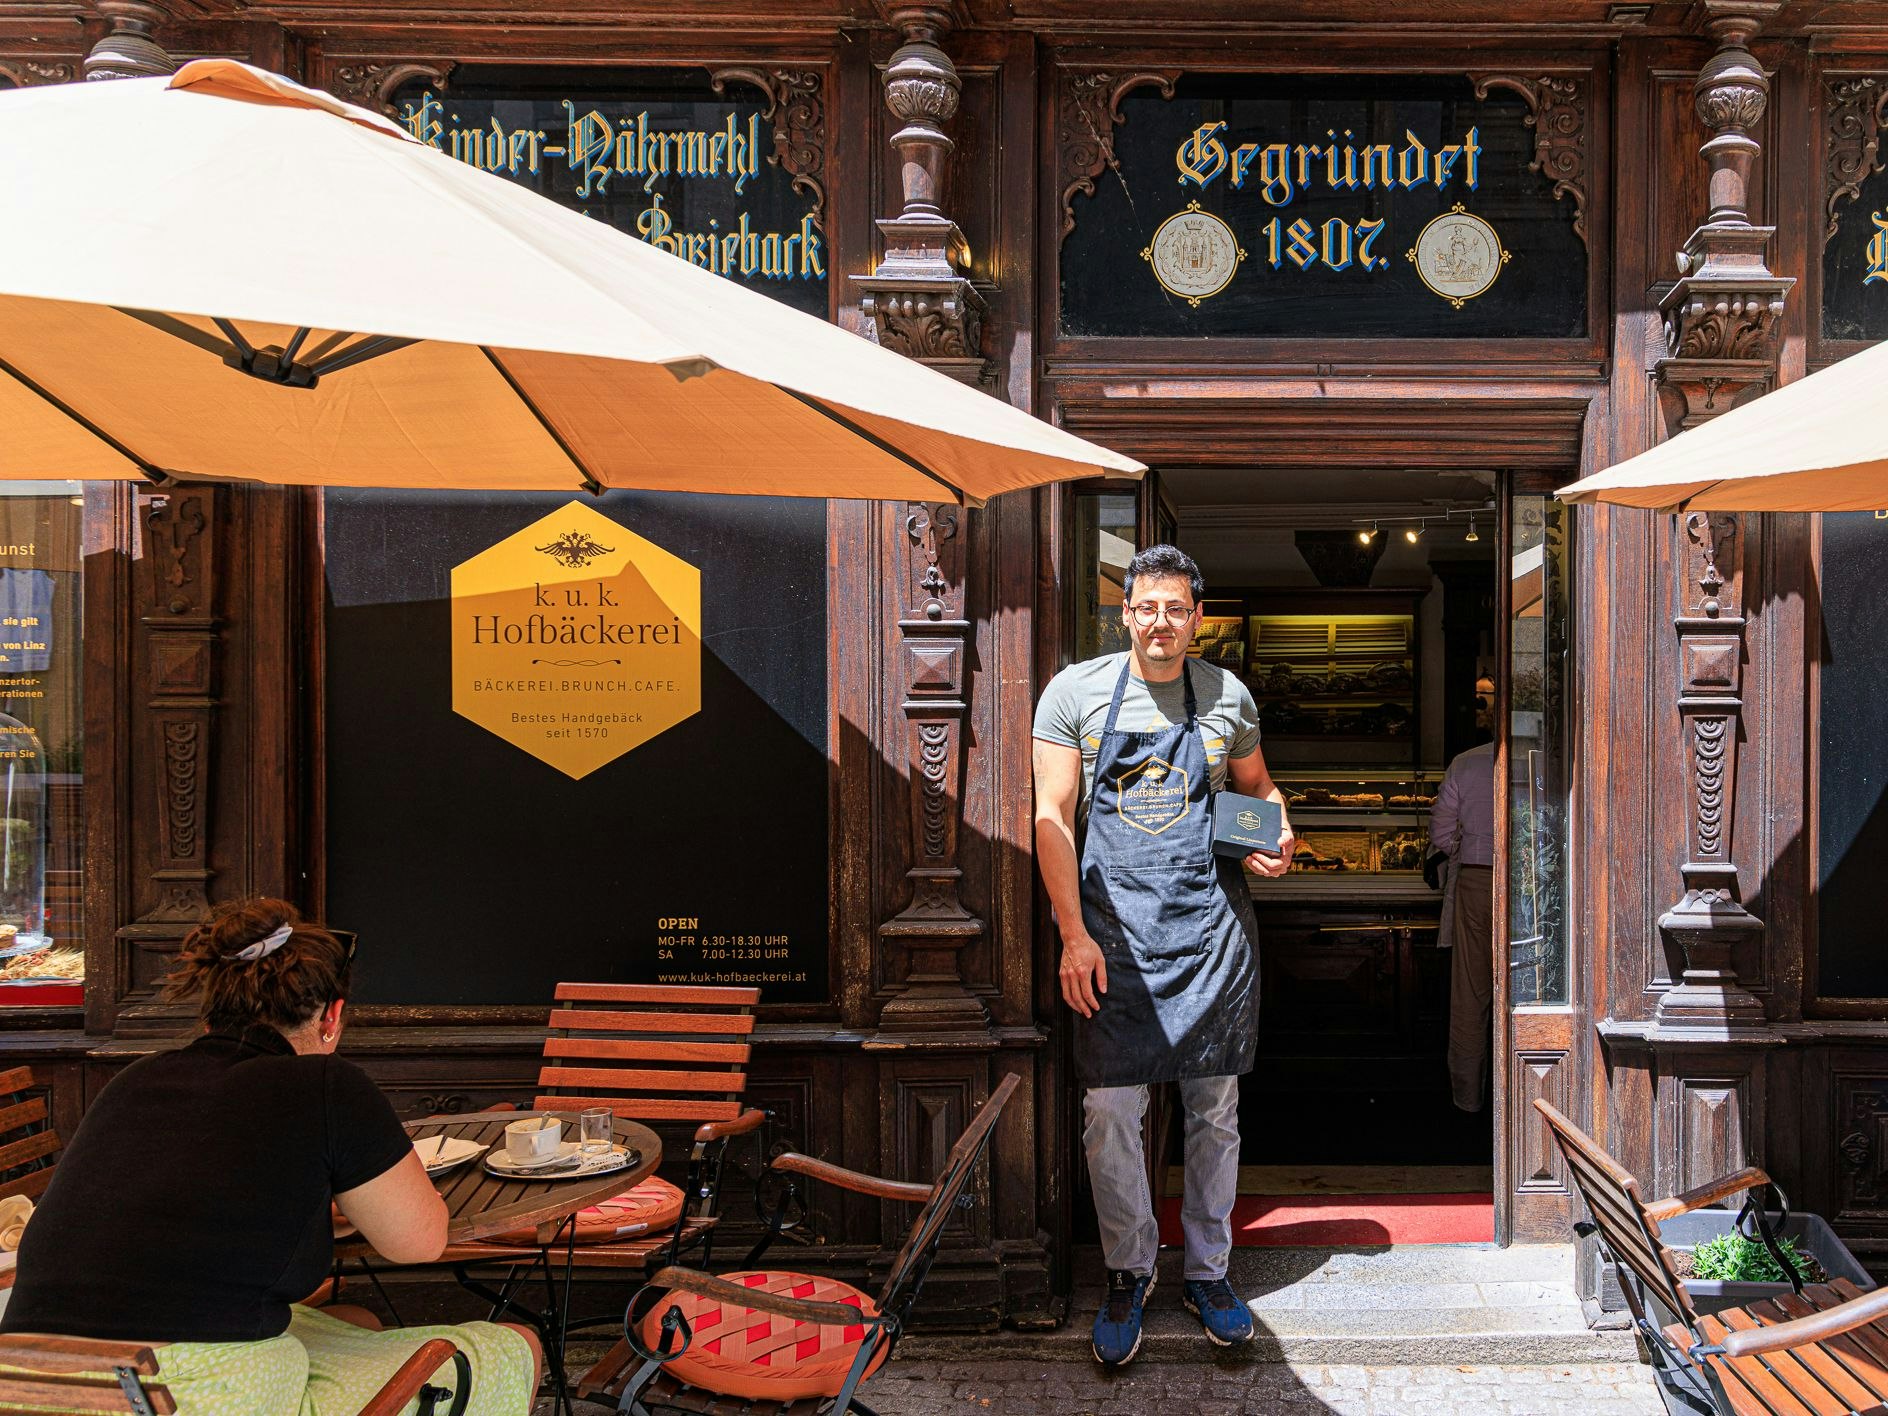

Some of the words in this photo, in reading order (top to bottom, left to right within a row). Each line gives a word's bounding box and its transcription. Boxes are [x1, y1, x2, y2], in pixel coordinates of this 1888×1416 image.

[1176, 120, 1482, 207] Gegründet
[1262, 216, 1390, 272] 1807.
[534, 583, 556, 607] k.
[565, 590, 588, 607] u.
[598, 583, 619, 607] k.
[20, 616, 39, 628] gilt
[472, 614, 682, 645] Hofbäckerei
[3, 642, 22, 650] von
[23, 640, 46, 650] Linz
[474, 678, 681, 692] BÄCKEREI.BRUNCH.CAFE.
[0, 689, 44, 698] rationen
[511, 712, 556, 723] Bestes
[562, 711, 643, 725] Handgebäck
[546, 727, 570, 738] seit
[577, 727, 609, 738] 1570
[19, 749, 36, 758] Sie
[1125, 785, 1184, 799] Hofbäckerei
[658, 917, 699, 930] OPEN
[658, 936, 695, 946] MO-FR
[702, 935, 761, 946] 6.30-18.30
[764, 935, 789, 945] UHR
[658, 949, 674, 959] SA
[702, 949, 761, 959] 7.00-12.30
[764, 948, 789, 959] UHR
[658, 971, 807, 983] www.kuk-hofbaeckerei.at
